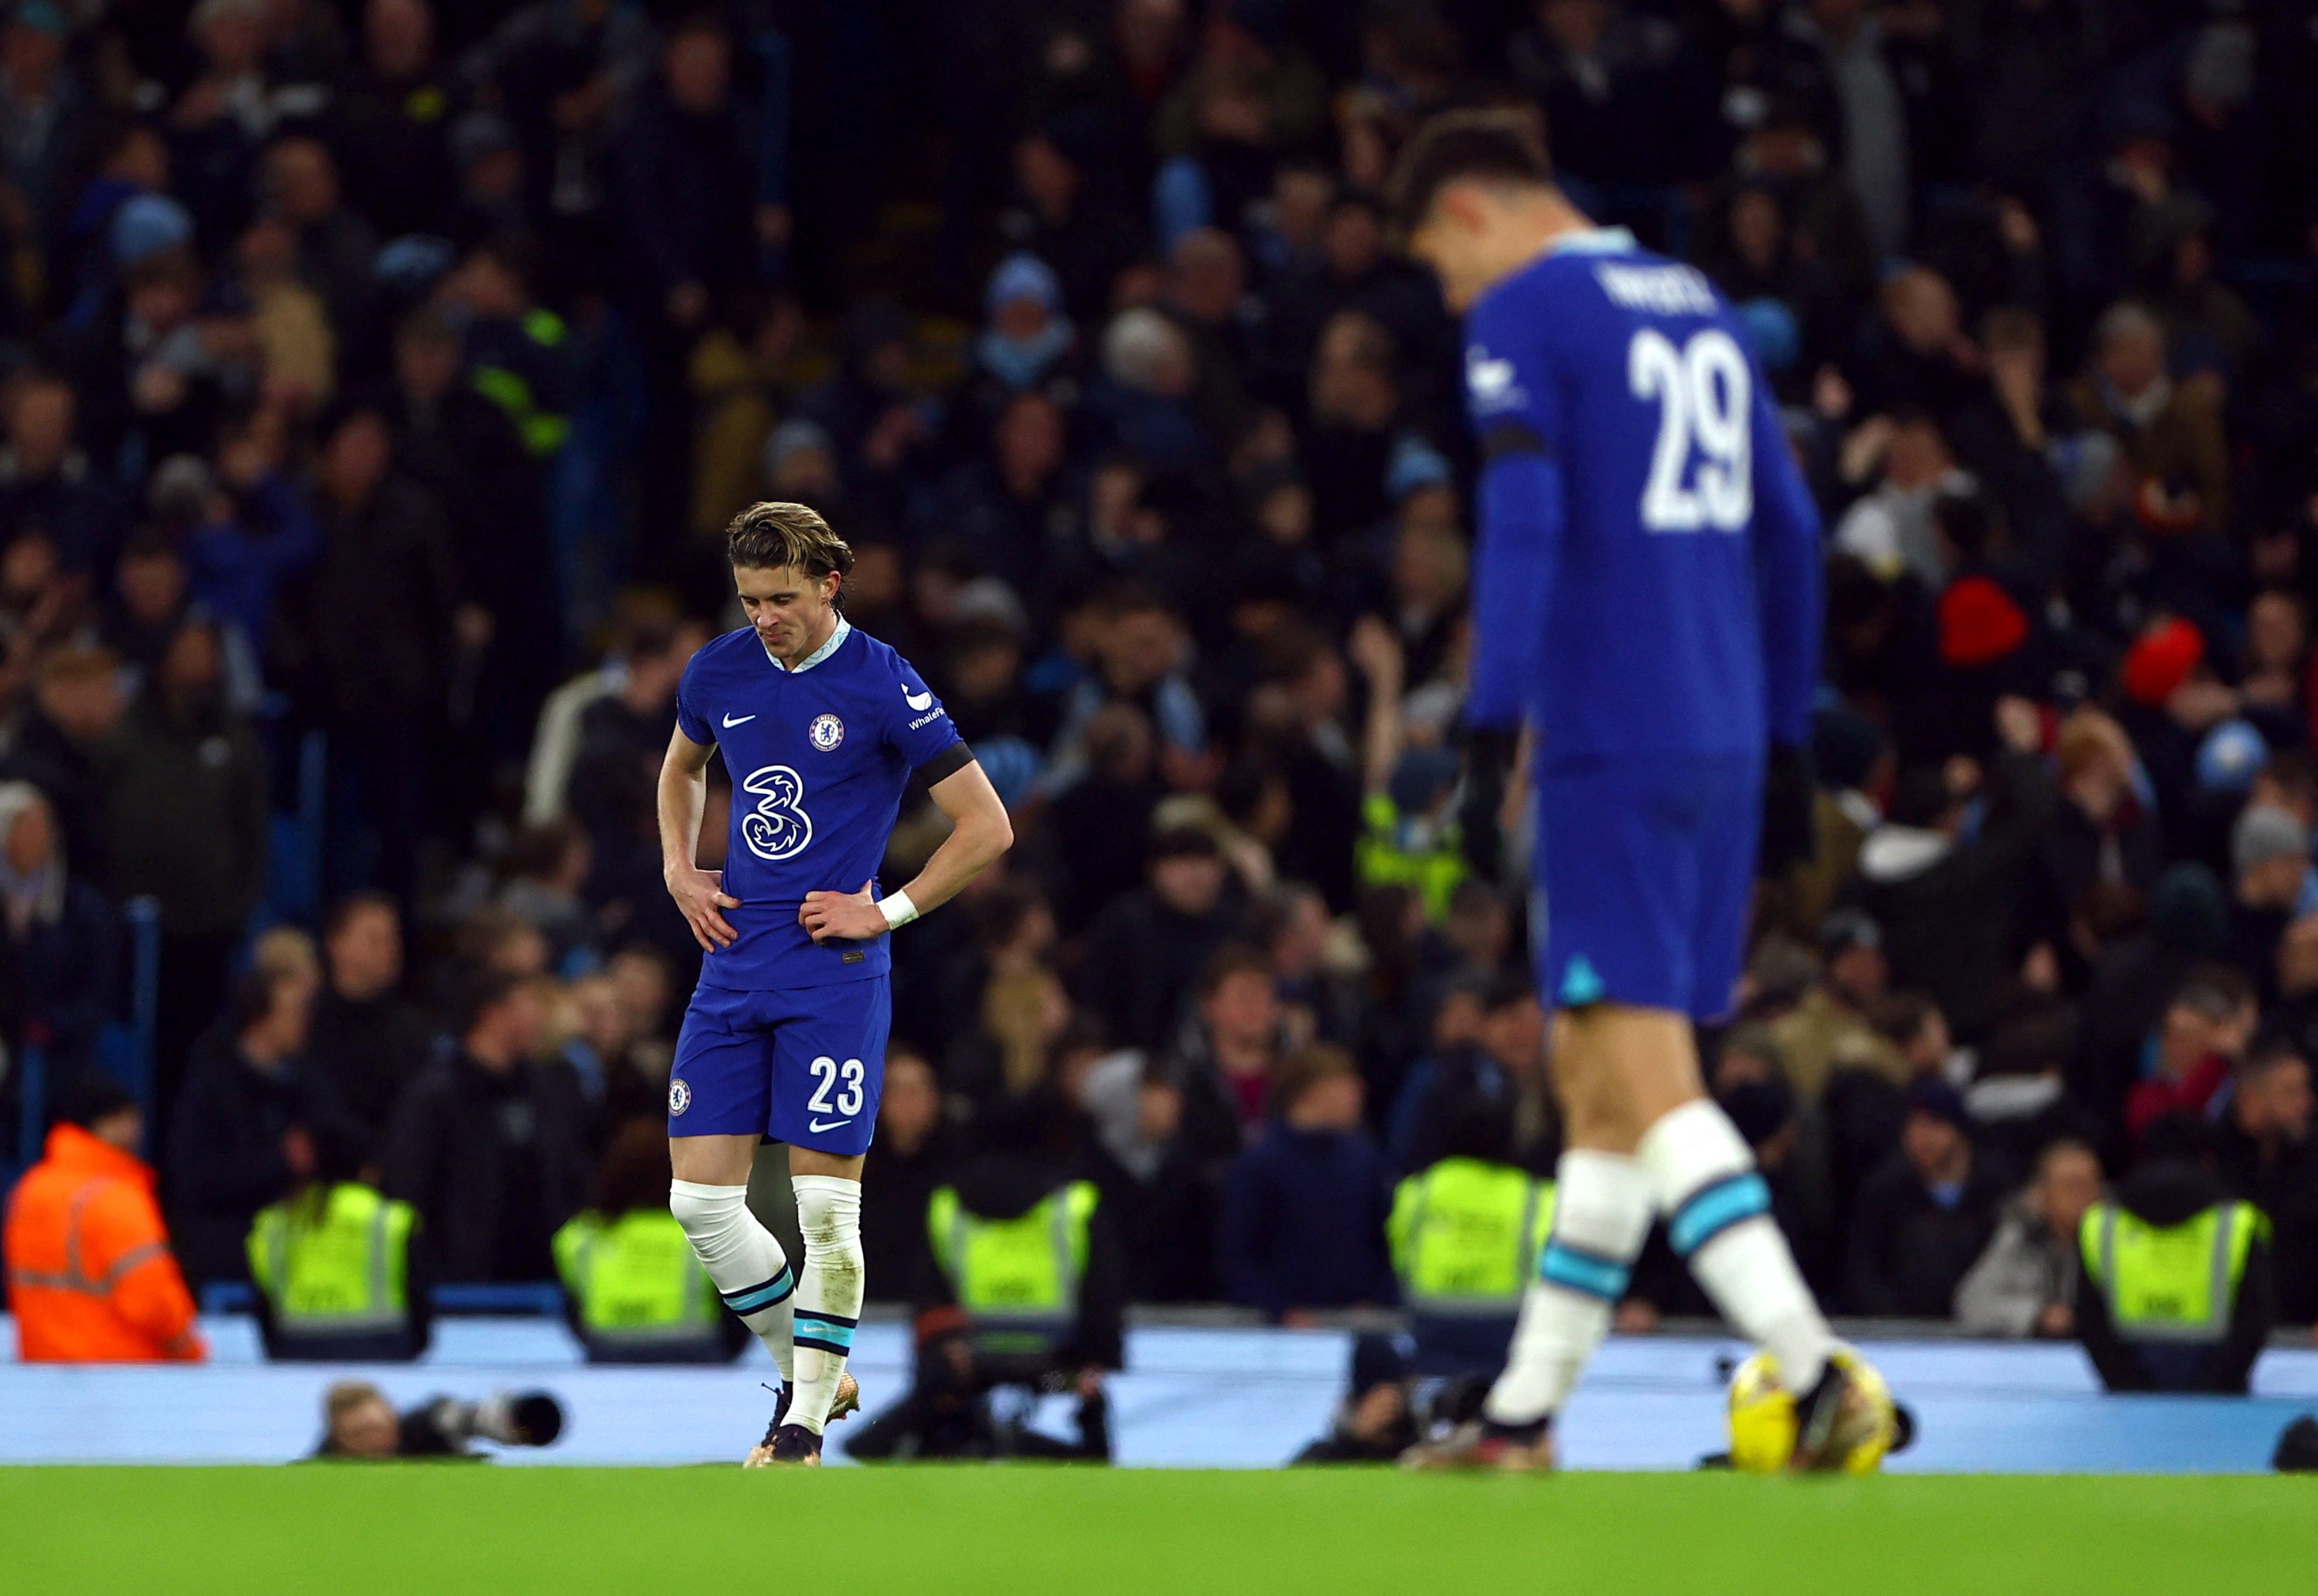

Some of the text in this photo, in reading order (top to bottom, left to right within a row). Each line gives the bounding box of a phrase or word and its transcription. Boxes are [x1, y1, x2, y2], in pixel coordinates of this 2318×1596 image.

[1628, 327, 1752, 531] 29
[816, 715, 839, 725] CHELSEA
[741, 765, 813, 859] 3
[807, 1056, 865, 1116] 23
